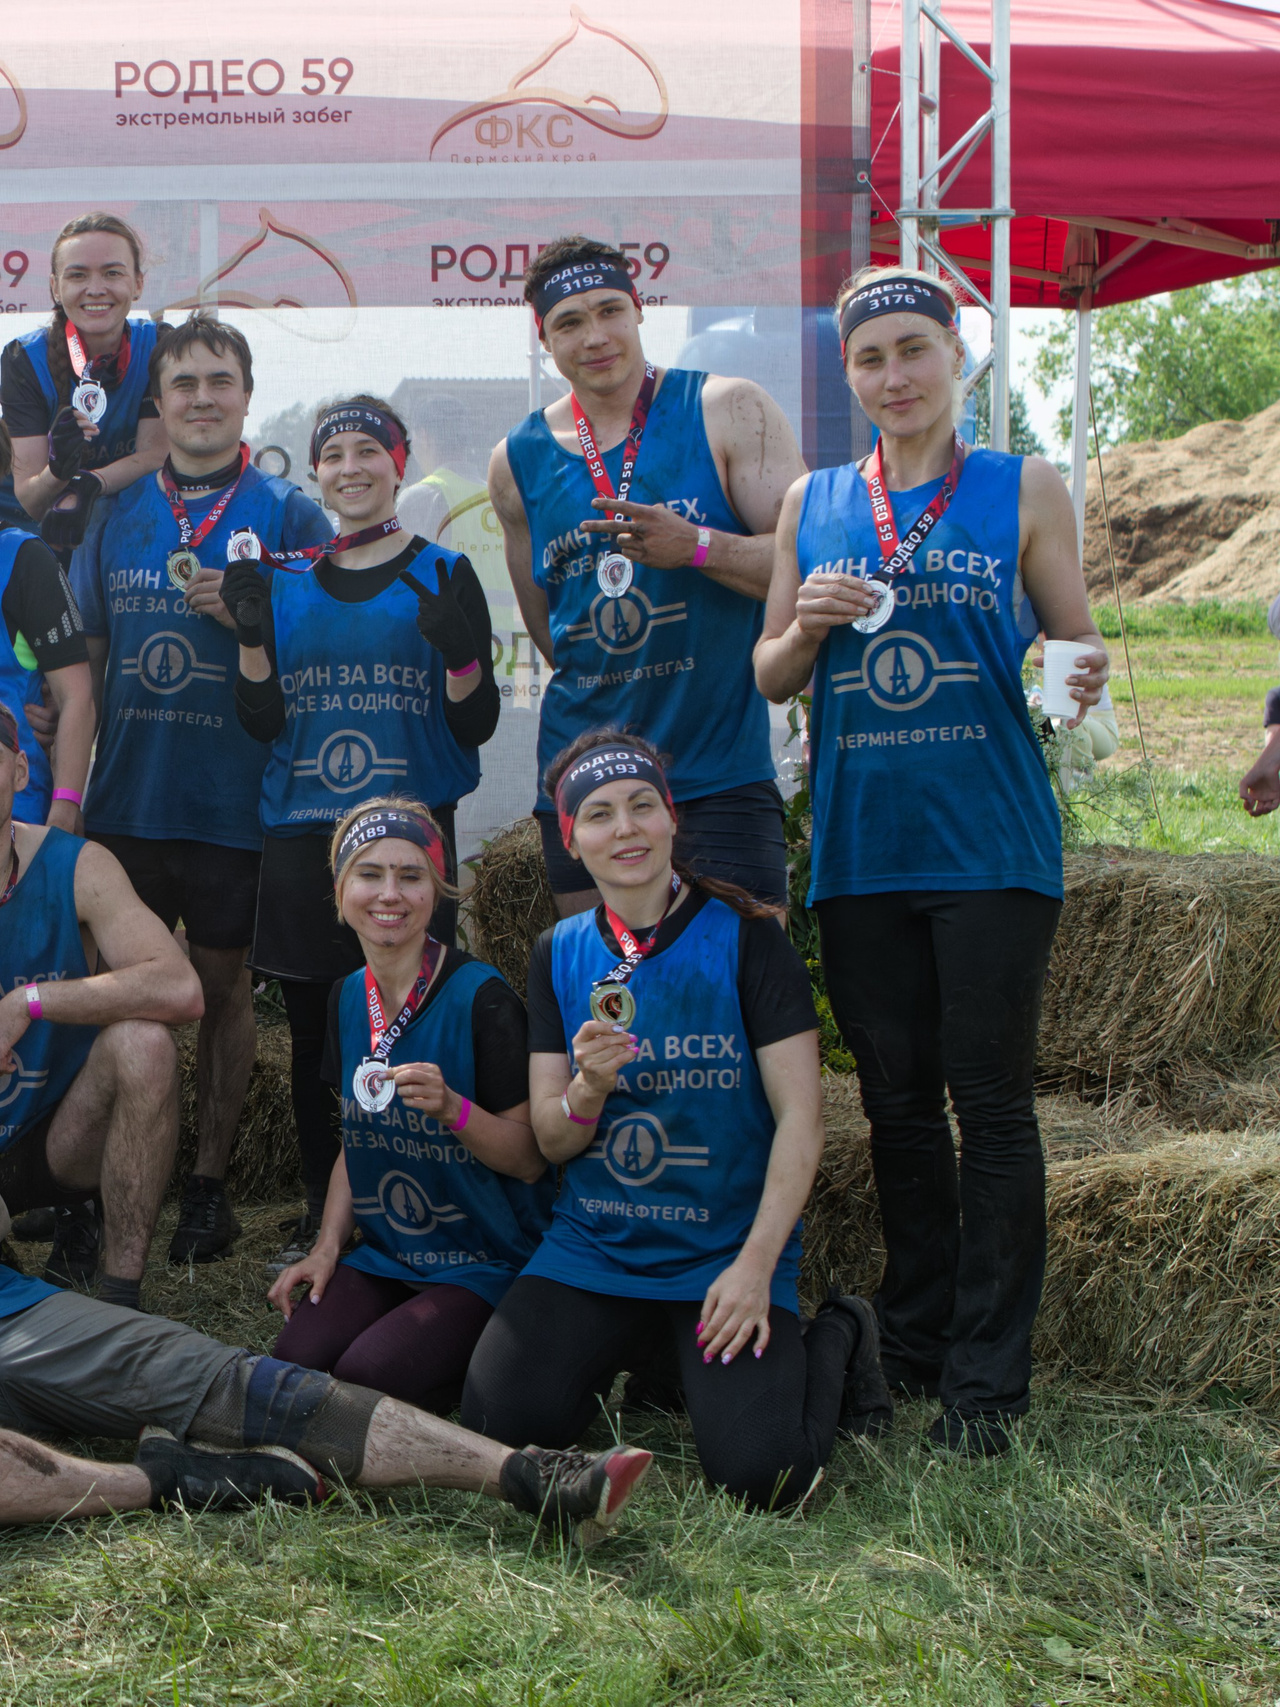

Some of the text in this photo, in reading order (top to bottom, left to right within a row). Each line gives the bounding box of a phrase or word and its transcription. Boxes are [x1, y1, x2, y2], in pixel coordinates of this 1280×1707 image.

[114, 57, 354, 103] РОДЕО 59
[115, 106, 353, 130] экстремальный забег
[474, 113, 574, 149] ФКС
[450, 152, 598, 165] Пермский край
[431, 245, 547, 289] РОД
[543, 262, 596, 291] РОДЕО
[560, 274, 605, 295] 3192
[848, 283, 932, 309] РОДЕО 59
[868, 294, 917, 312] 3176
[317, 410, 382, 434] РОДЕО 59
[329, 422, 363, 436] 3187
[576, 417, 604, 479] РОДЕО 59
[621, 461, 634, 478] 59
[208, 509, 222, 521] 59
[869, 476, 894, 542] РОДЕО 59
[542, 529, 593, 571] ОДИН
[883, 512, 934, 576] РОДЕО 59
[108, 568, 161, 593] ОДИН
[924, 549, 1002, 589] ВСЕХ,
[116, 596, 140, 614] ВСЕ
[145, 597, 168, 614] ЗА
[894, 582, 1001, 614] ОДНОГО!
[337, 664, 367, 686] ЗА
[373, 663, 432, 695] ВСЕХ,
[577, 656, 696, 690] ПЕРМНЕФТЕГАЗ
[117, 708, 223, 728] ПЕРМНЕФТЕГАЗ
[321, 694, 343, 711] ЗА
[348, 693, 430, 717] ОДНОГО!
[569, 751, 654, 782] РОДЕО 59
[592, 763, 639, 782] 3193
[339, 812, 409, 854] РОДЕО 59
[350, 824, 387, 850] 3189
[368, 986, 384, 1029] РОДЕО
[398, 1006, 412, 1026] 59
[664, 1034, 743, 1064] ВСЕХ,
[636, 1067, 742, 1095] ОДНОГО!
[380, 1105, 405, 1128] ЗА
[367, 1131, 390, 1151] ЗА
[577, 1197, 710, 1223] ПЕРМНЕФТЕГАЗ
